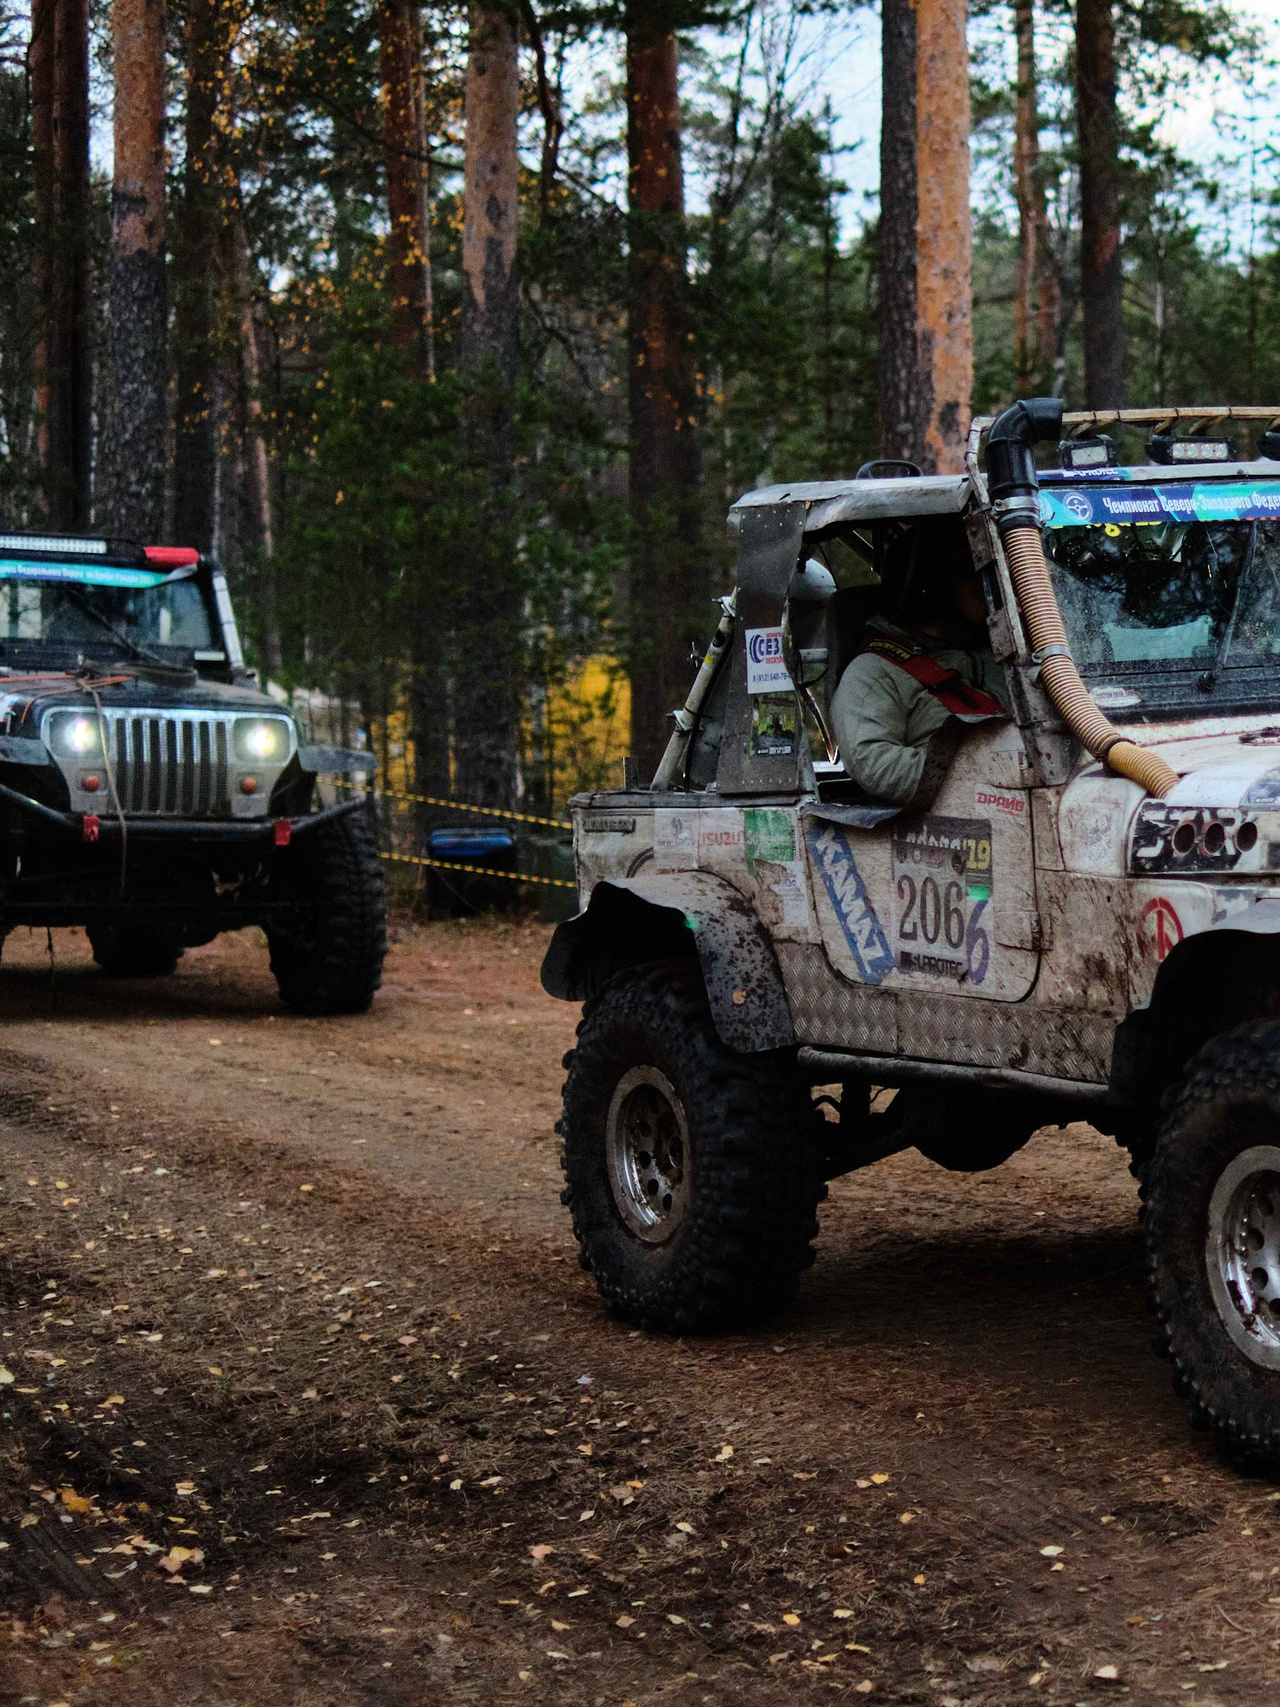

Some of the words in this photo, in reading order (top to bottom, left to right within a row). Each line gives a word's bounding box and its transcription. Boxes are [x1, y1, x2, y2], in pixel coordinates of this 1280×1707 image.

[1103, 497, 1161, 515] Чемпионат
[1162, 493, 1252, 517] Северо-Западного
[702, 831, 741, 846] ISUZU
[897, 876, 964, 949] 206
